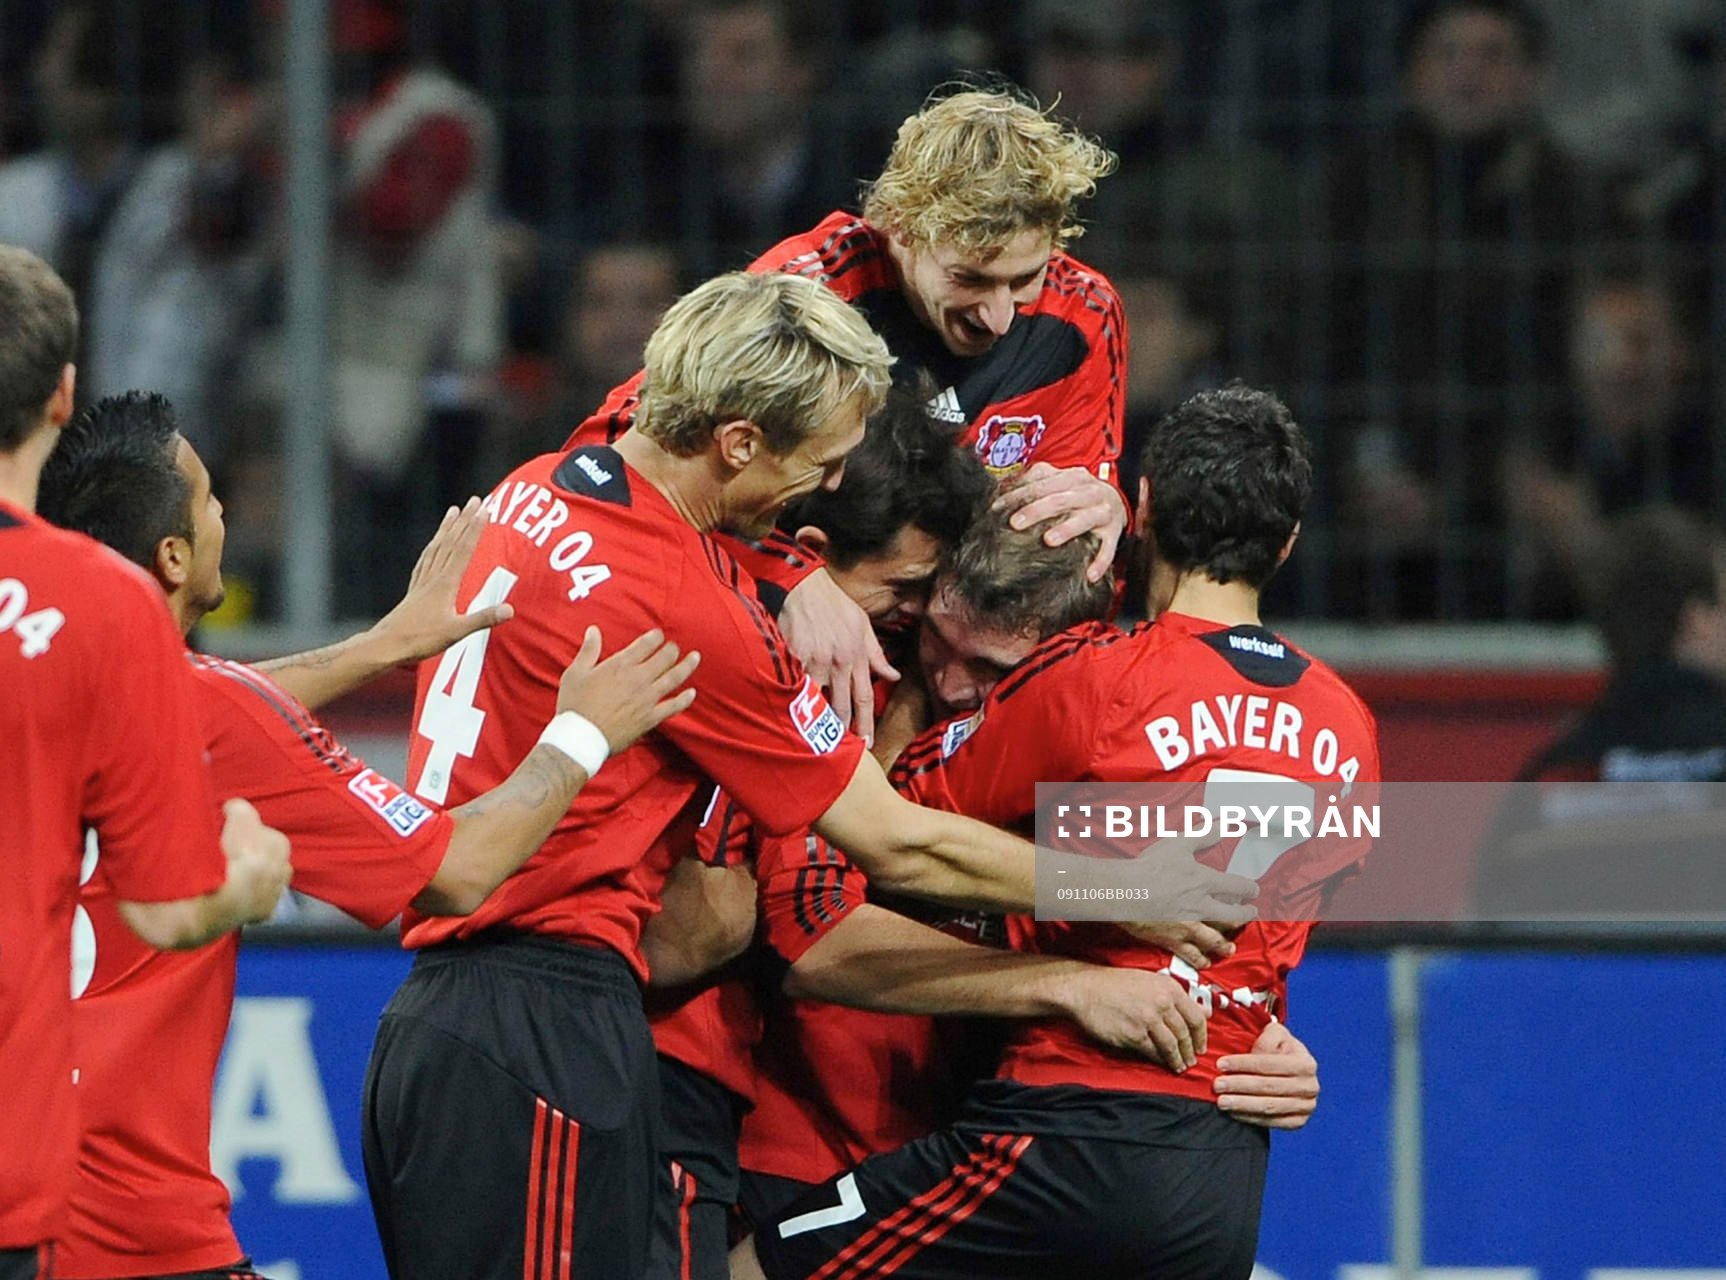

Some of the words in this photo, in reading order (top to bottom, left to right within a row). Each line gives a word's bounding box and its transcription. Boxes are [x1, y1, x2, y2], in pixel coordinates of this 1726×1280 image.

[479, 481, 569, 548] AYER
[549, 530, 612, 602] 04
[418, 566, 519, 806] 4
[1144, 694, 1303, 771] BAYER
[1312, 727, 1360, 800] 04
[1202, 768, 1315, 881] 7
[777, 1172, 866, 1239] 7
